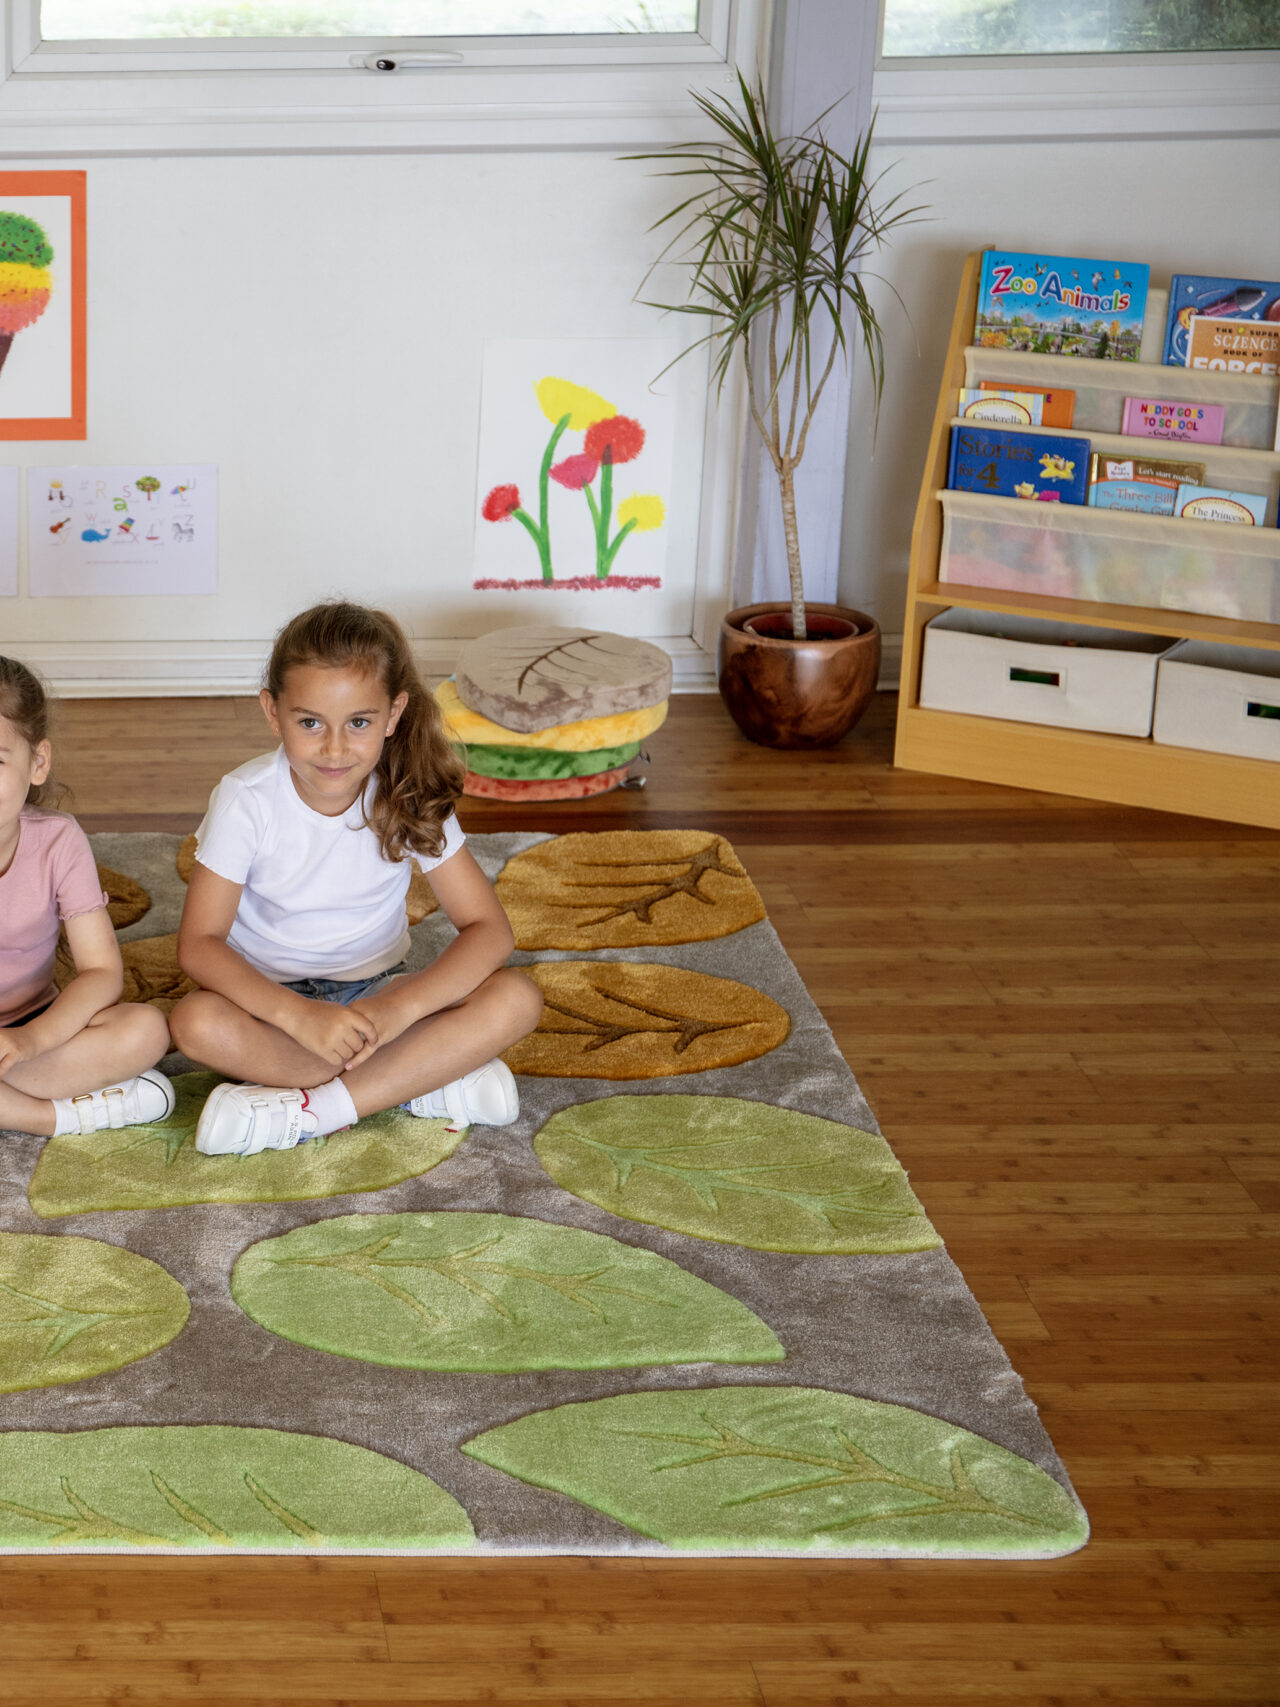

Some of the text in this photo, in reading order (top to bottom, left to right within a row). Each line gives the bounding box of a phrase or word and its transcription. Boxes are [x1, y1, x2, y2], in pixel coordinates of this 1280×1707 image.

[990, 266, 1130, 312] Zoo Animals
[1216, 326, 1233, 334] THE
[1213, 334, 1278, 351] SCIENCE
[1193, 356, 1280, 376] FORCE
[972, 412, 1022, 424] Cinderella
[1141, 404, 1204, 419] NODDY GOES
[1144, 416, 1198, 431] TO SCHOOL
[960, 434, 1034, 462] Stories
[958, 462, 1000, 489] for 4
[1138, 466, 1154, 476] Let's
[1155, 471, 1171, 479] start
[1172, 473, 1199, 486] reading
[96, 480, 106, 499] R
[122, 486, 131, 498] S
[1116, 488, 1152, 503] Three
[1193, 507, 1208, 516] The
[1211, 510, 1246, 522] Princess
